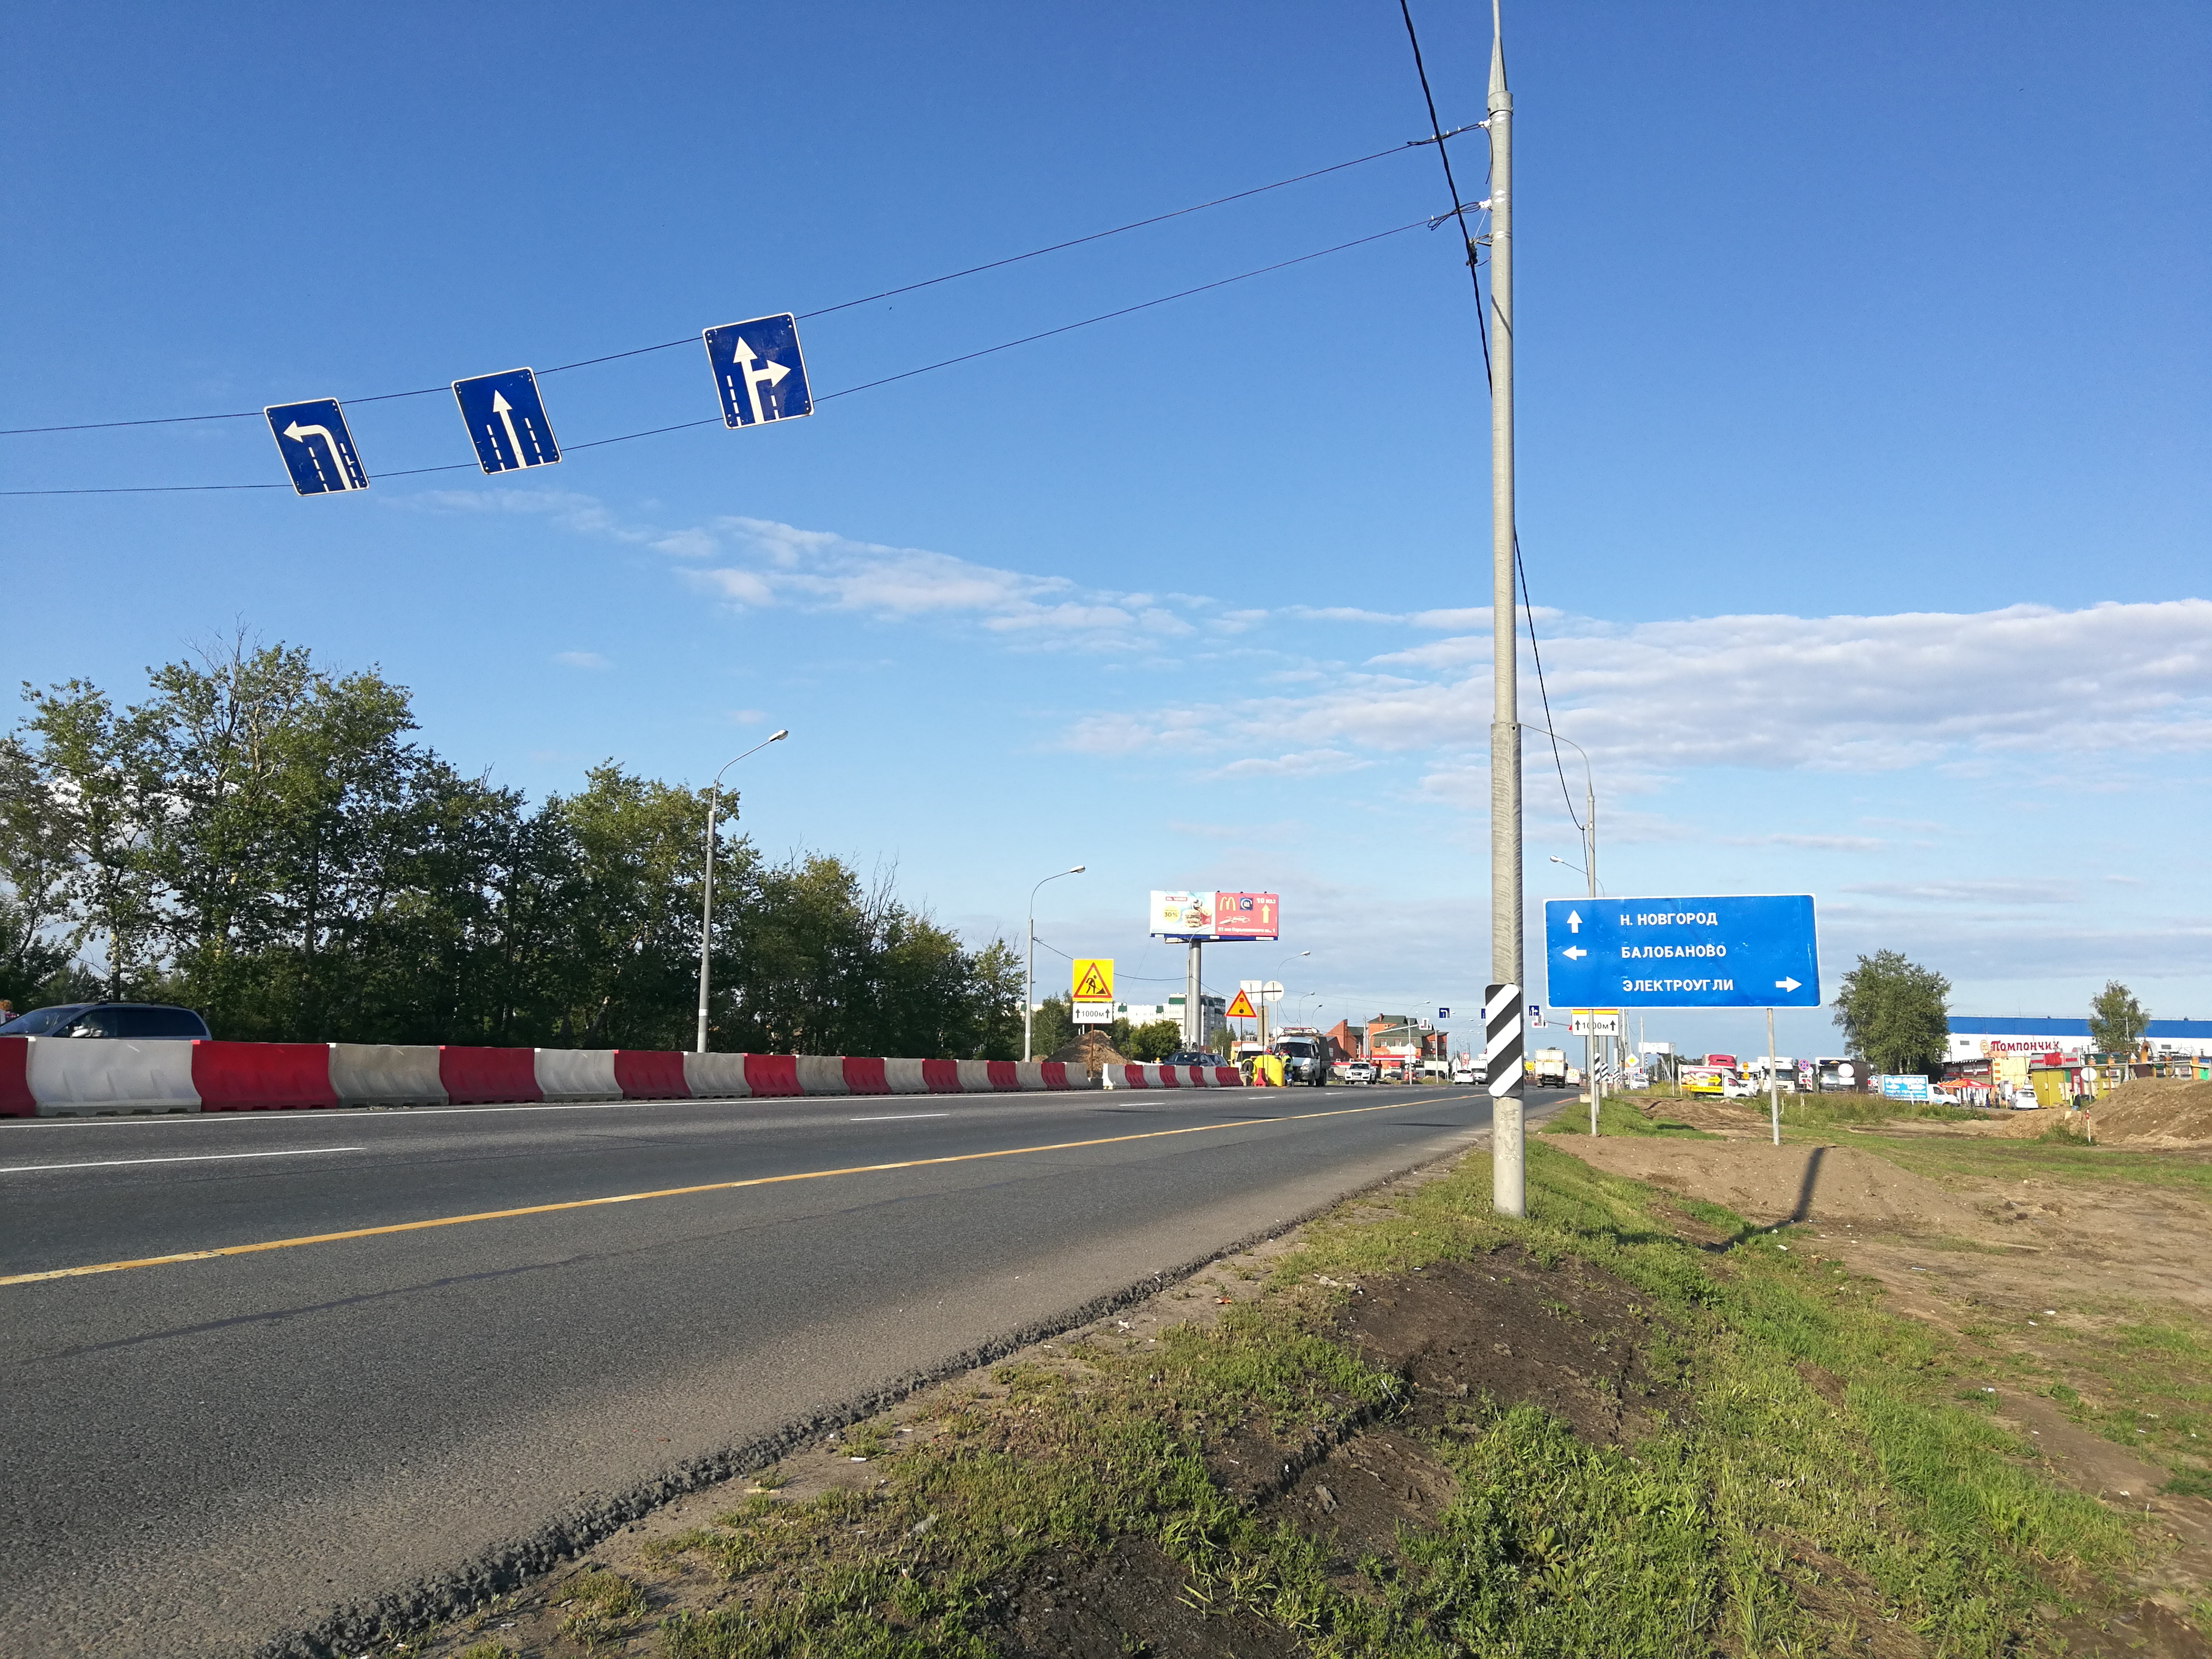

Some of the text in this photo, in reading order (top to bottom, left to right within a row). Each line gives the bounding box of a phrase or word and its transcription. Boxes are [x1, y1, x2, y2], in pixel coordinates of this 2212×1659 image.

[1620, 912, 1718, 926] Н. НОВГОРОД
[1621, 945, 1726, 958] БАЛОБАНОВО
[1622, 979, 1734, 992] ЭЛЕКТРОУГЛИ
